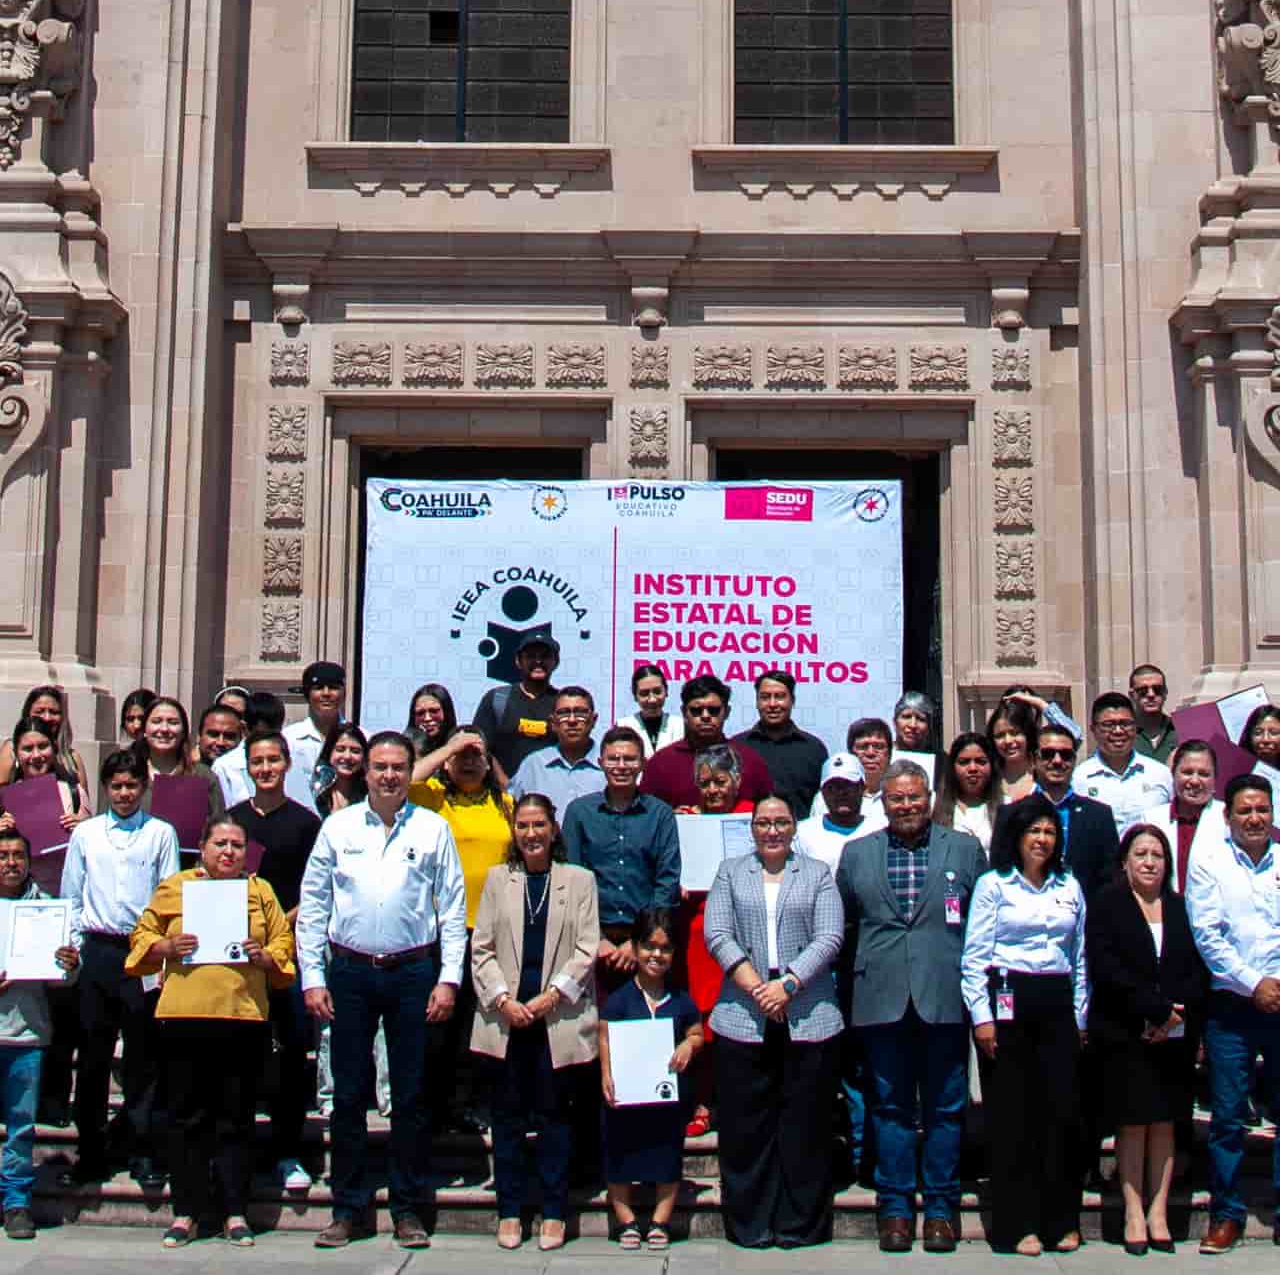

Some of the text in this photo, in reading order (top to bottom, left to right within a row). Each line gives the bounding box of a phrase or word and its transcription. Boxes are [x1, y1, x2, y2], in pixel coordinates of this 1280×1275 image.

[380, 488, 492, 511] COAHUILA
[616, 502, 678, 511] EDUCATIVO
[766, 492, 807, 506] SEDU
[618, 510, 674, 518] COAHUILA
[451, 566, 588, 623] IEEA COAHUILA
[633, 573, 797, 598] INSTITUTO
[633, 602, 812, 626] ESTATAL DE
[633, 627, 819, 654] EDUCACIÓN
